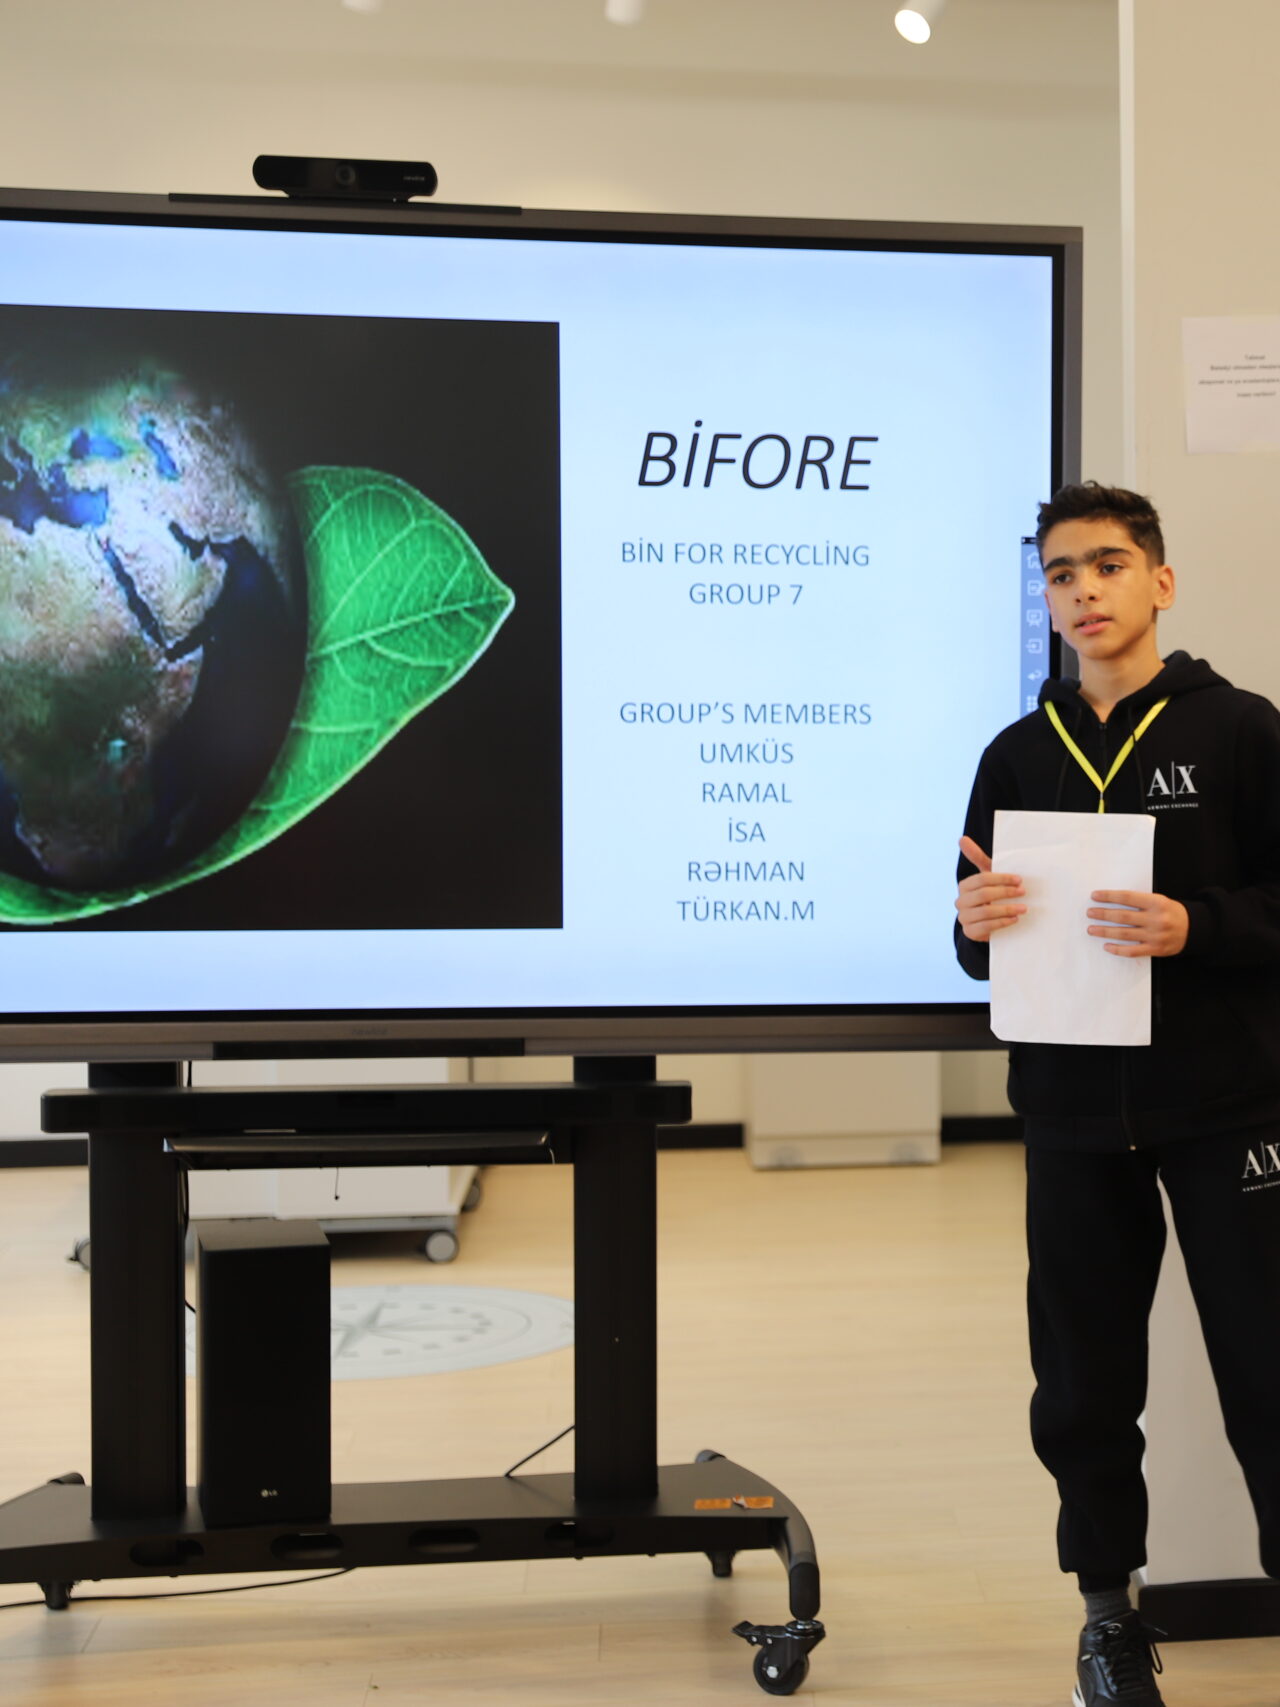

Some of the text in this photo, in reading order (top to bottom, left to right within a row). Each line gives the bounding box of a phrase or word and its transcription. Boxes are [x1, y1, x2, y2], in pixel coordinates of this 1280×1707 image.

[638, 420, 879, 491] BİFORE
[621, 537, 870, 566] BİN FOR RECYCLİNG
[689, 583, 804, 605] GROUP 7
[744, 703, 872, 725] MEMBERS
[699, 739, 794, 764] UMKÜS
[702, 781, 793, 803] RAMAL
[727, 817, 766, 843] İSA
[687, 860, 806, 883] RƏHMAN
[676, 896, 815, 922] TÜRKAN.M
